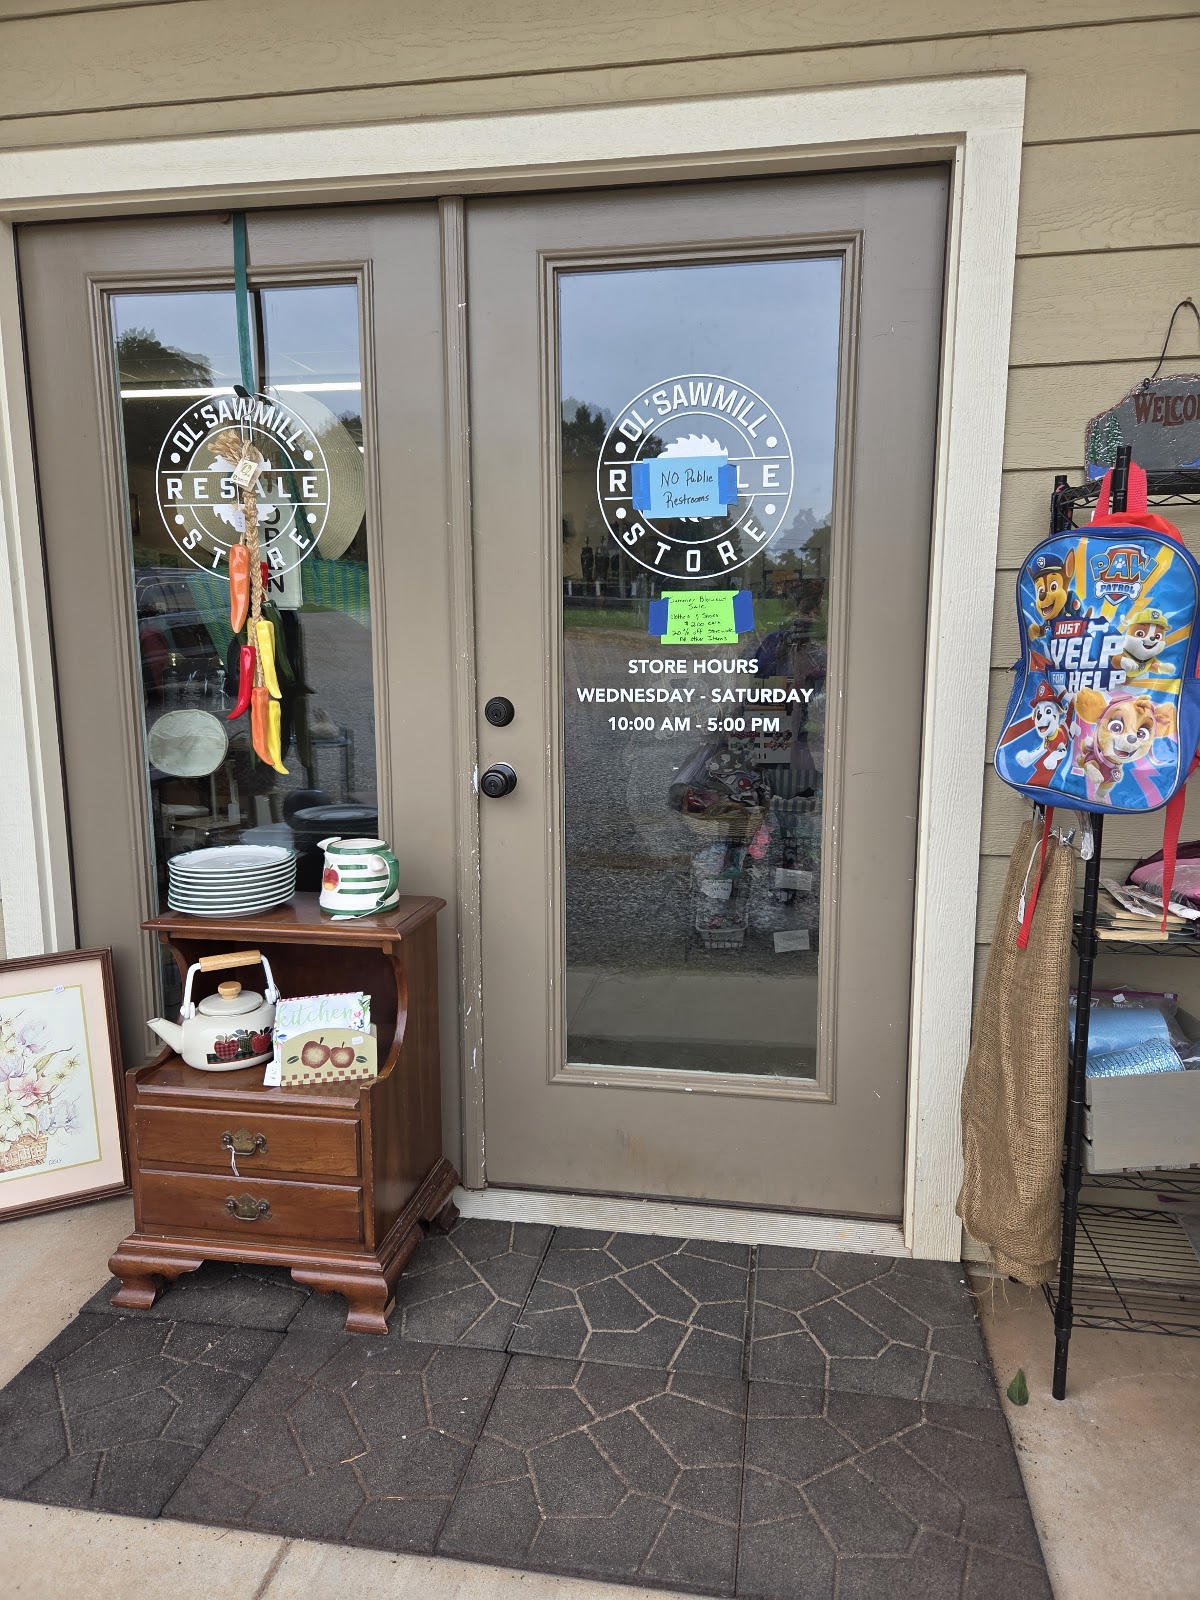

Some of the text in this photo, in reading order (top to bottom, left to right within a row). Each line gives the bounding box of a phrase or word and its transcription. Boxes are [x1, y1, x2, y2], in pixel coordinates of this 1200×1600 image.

[1132, 392, 1200, 427] WELCO
[609, 464, 780, 493] RLE
[661, 467, 714, 488] NO Public
[662, 491, 710, 508] Restrooms
[182, 527, 311, 571] STRE
[622, 519, 766, 573] STORE
[1089, 552, 1159, 584] PAW
[1099, 583, 1136, 595] PATROL
[1055, 622, 1081, 635] JUST
[1050, 634, 1125, 670] YELP
[628, 659, 760, 674] STORE HOURS
[1052, 670, 1127, 694] FOR HELP
[576, 688, 696, 703] WEDNESDAY
[711, 688, 815, 703] SATURDAY
[607, 716, 655, 731] 10:00
[660, 717, 691, 732] AM
[707, 717, 746, 732] 5:00
[751, 717, 780, 732] PM
[276, 1000, 353, 1028] kitchen
